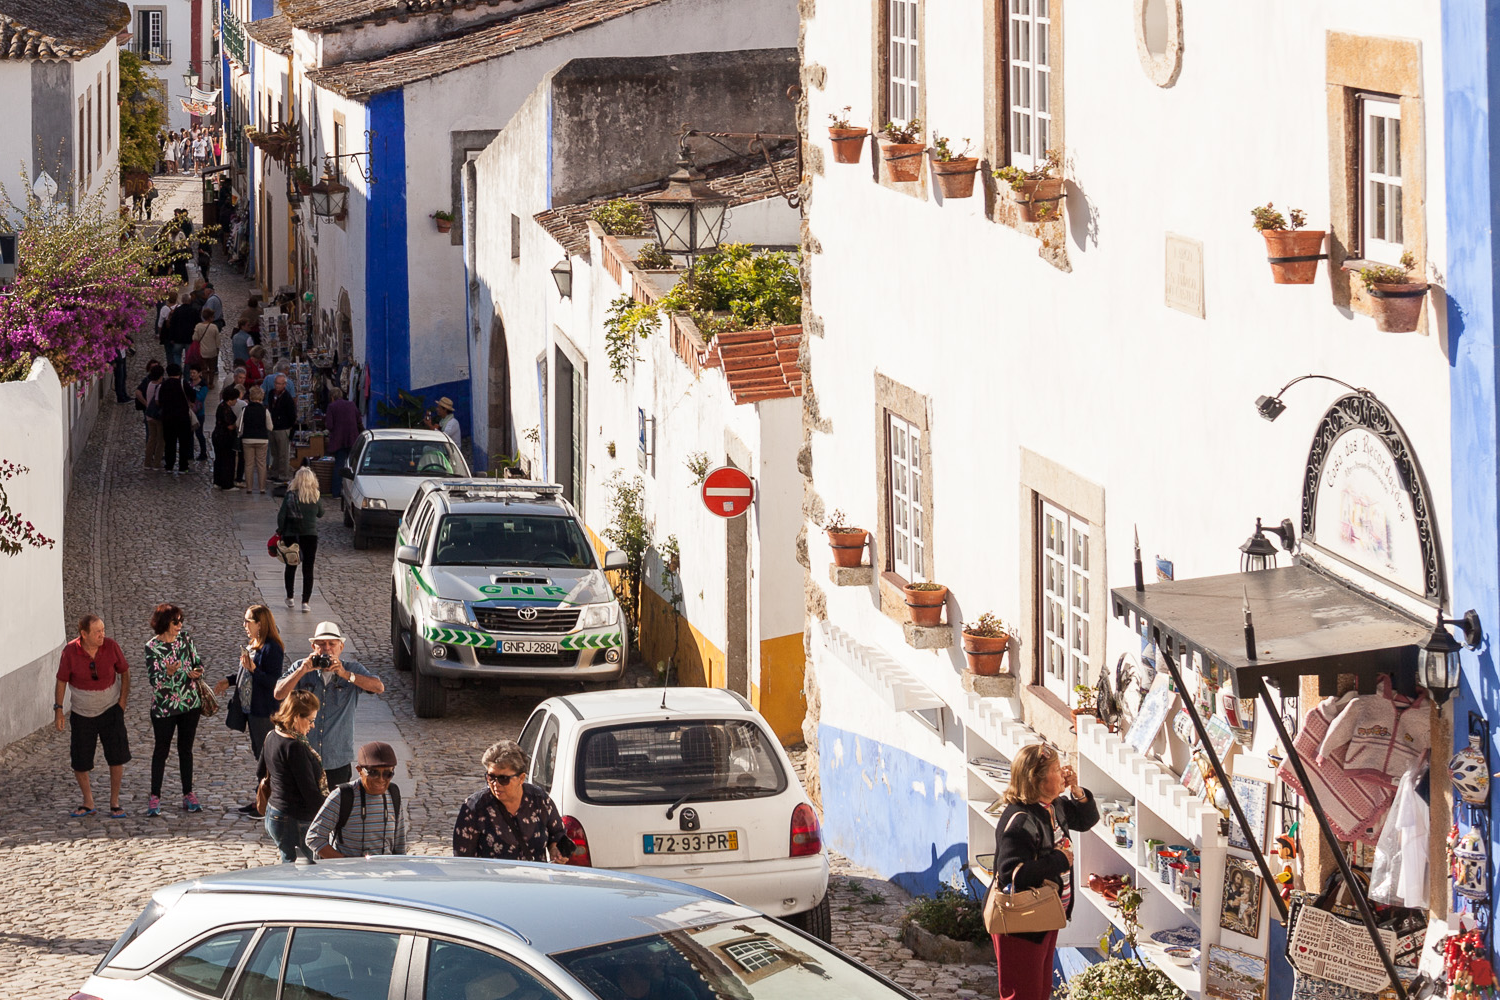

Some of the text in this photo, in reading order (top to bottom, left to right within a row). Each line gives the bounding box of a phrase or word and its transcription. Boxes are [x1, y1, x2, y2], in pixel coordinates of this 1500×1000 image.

[1327, 455, 1343, 488] Casa
[1345, 438, 1358, 457] das
[478, 585, 570, 596] GNR
[1334, 923, 1365, 939] PORTUGAL
[1297, 938, 1319, 948] PORTO
[1308, 948, 1348, 966] PORTUGAL
[1324, 972, 1348, 984] ALGARVE
